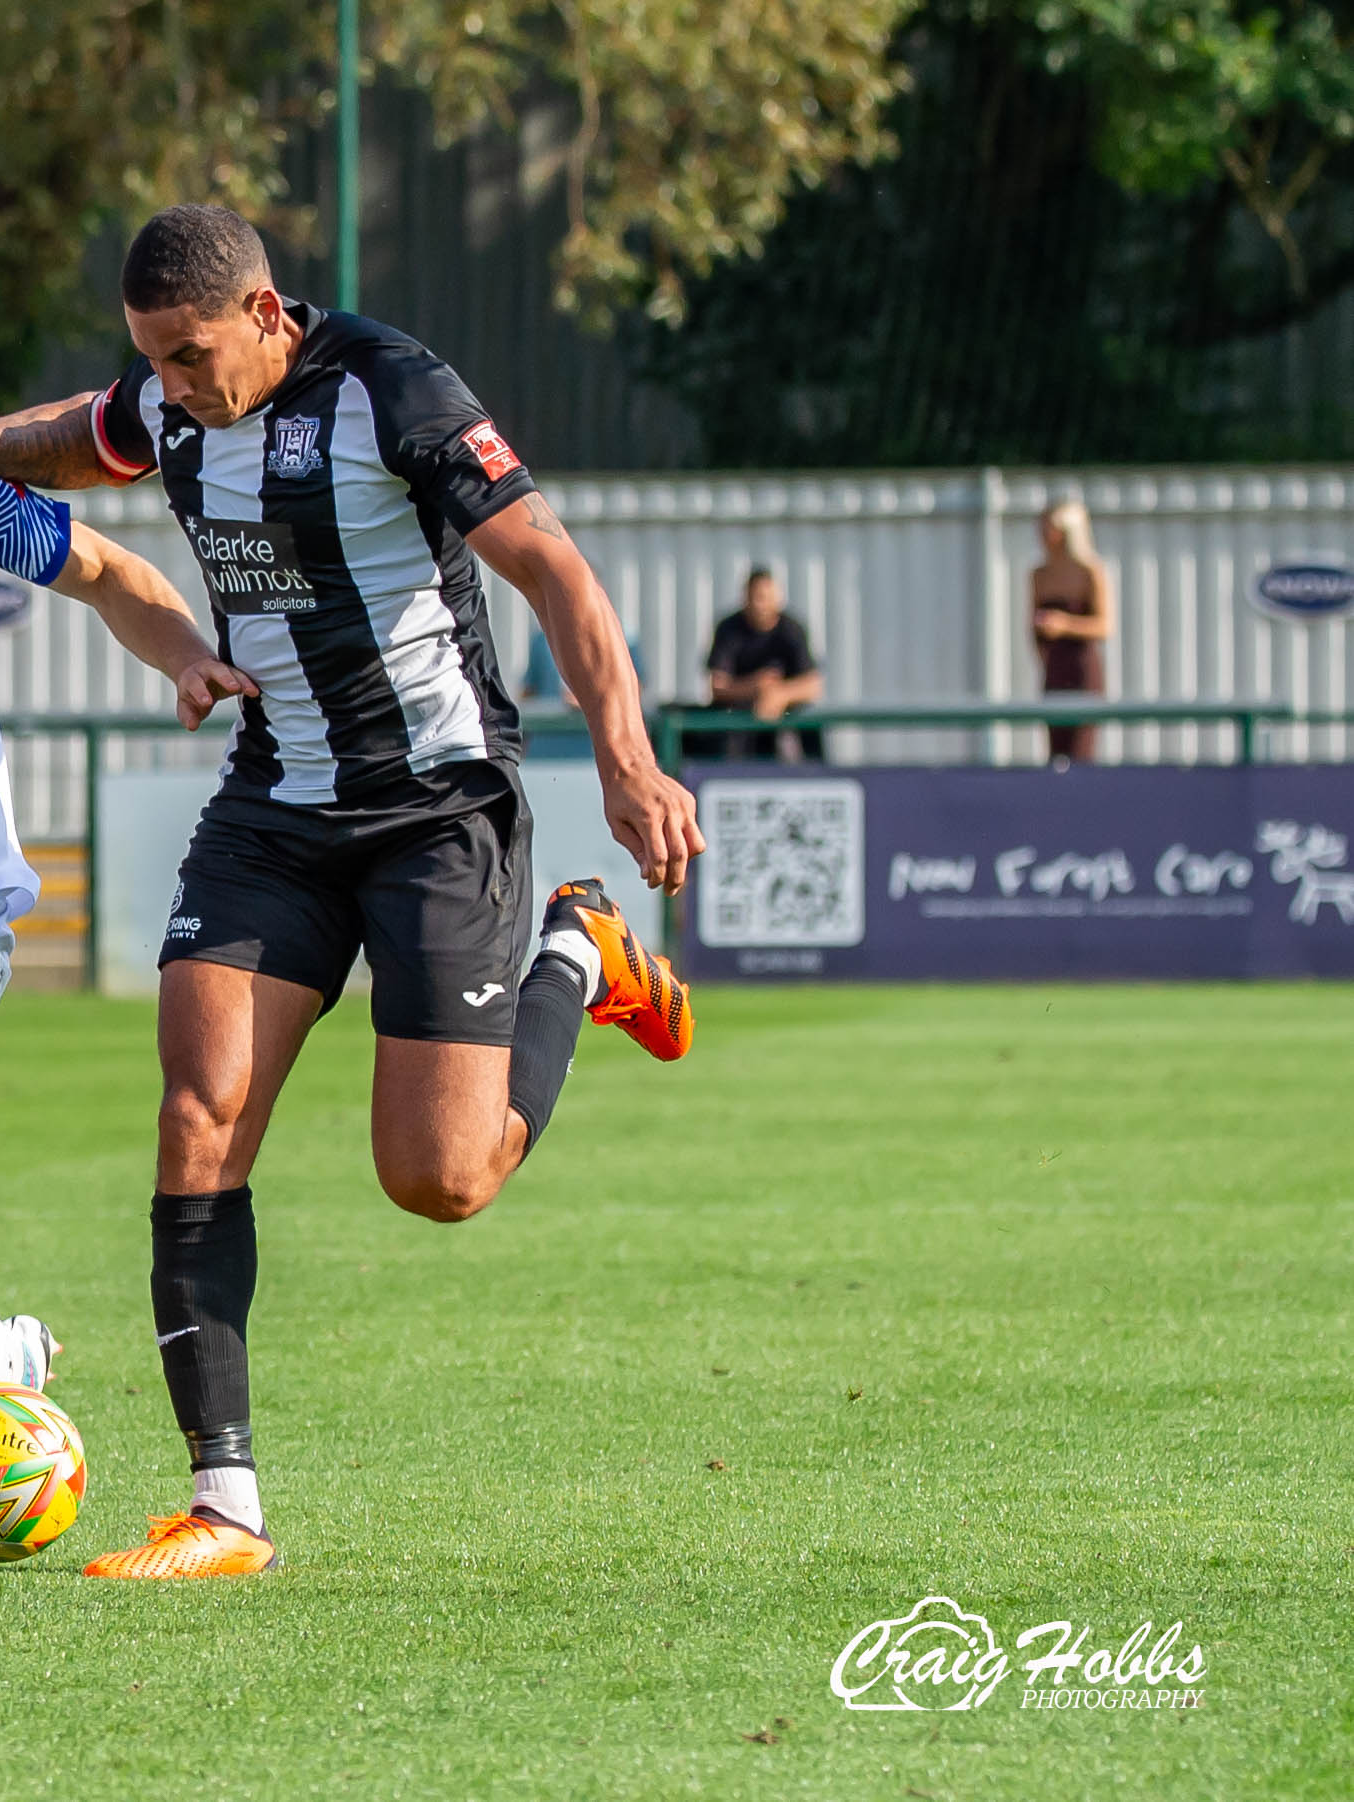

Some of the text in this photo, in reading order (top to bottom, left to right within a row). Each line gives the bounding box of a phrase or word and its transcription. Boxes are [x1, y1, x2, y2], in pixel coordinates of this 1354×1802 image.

[197, 528, 275, 563] clarke
[263, 597, 317, 611] solicitors
[171, 931, 196, 939] VINYL
